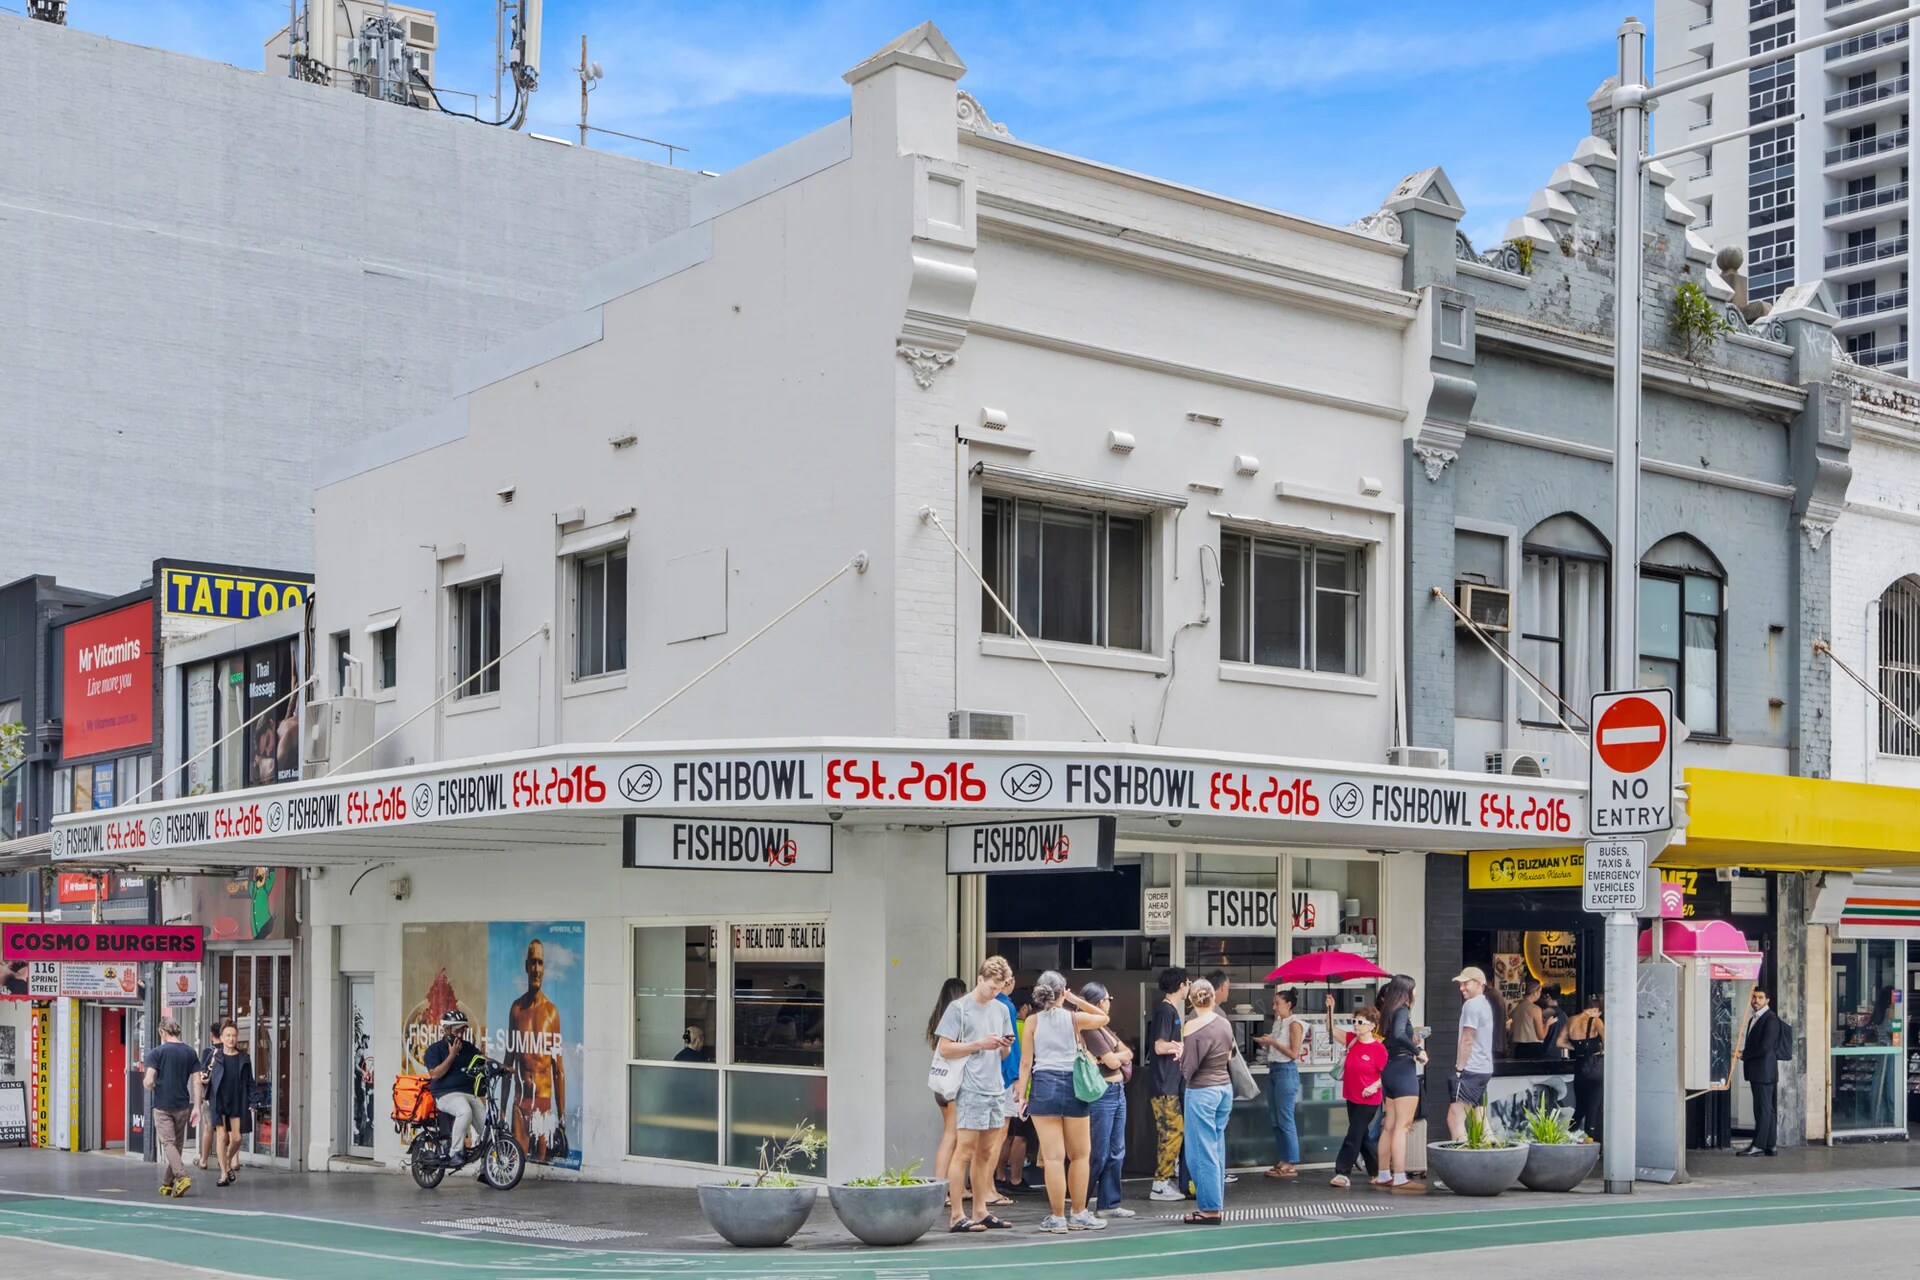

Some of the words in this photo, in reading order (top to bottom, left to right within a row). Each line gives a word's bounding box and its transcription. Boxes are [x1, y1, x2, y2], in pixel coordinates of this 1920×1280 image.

[172, 574, 303, 617] TATTOO
[79, 647, 93, 673] Mr
[93, 636, 140, 669] Vitamins
[256, 661, 270, 678] Thai
[87, 677, 101, 697] Live
[118, 673, 132, 694] you
[249, 681, 276, 698] Massage
[674, 760, 813, 801] FISHBOWL
[1066, 764, 1200, 809] FISHBOWL
[1612, 778, 1648, 800] NO
[438, 773, 507, 816] FISHBOWL
[287, 793, 343, 831] FISHBOWL
[1372, 785, 1471, 826] FISHBOWL
[166, 810, 211, 844] FISHBOWL
[1597, 807, 1665, 827] ENTRY
[66, 825, 104, 855] FISHBOWL
[673, 824, 796, 863] FISHBOWL
[973, 824, 1069, 864] FISHBOWL
[1599, 846, 1630, 858] BUSES,
[1517, 857, 1559, 870] GUZMAN
[1561, 856, 1568, 866] Y
[1597, 858, 1623, 868] TAXIS
[1625, 858, 1631, 868] &
[1588, 870, 1641, 881] EMERGENCY
[1593, 882, 1635, 892] VEHICLES
[1591, 894, 1636, 904] EXCEPTED
[1148, 911, 1162, 919] PICK
[10, 933, 90, 951] COSMO
[96, 934, 196, 952] BURGERS
[746, 928, 763, 948] REAL
[766, 928, 784, 948] FOOD
[791, 928, 809, 948] REAL
[34, 962, 55, 974] 116
[1540, 958, 1548, 969] Y
[31, 975, 58, 983] SPRING
[31, 985, 57, 993] STREET
[495, 1028, 563, 1057] SUMMER
